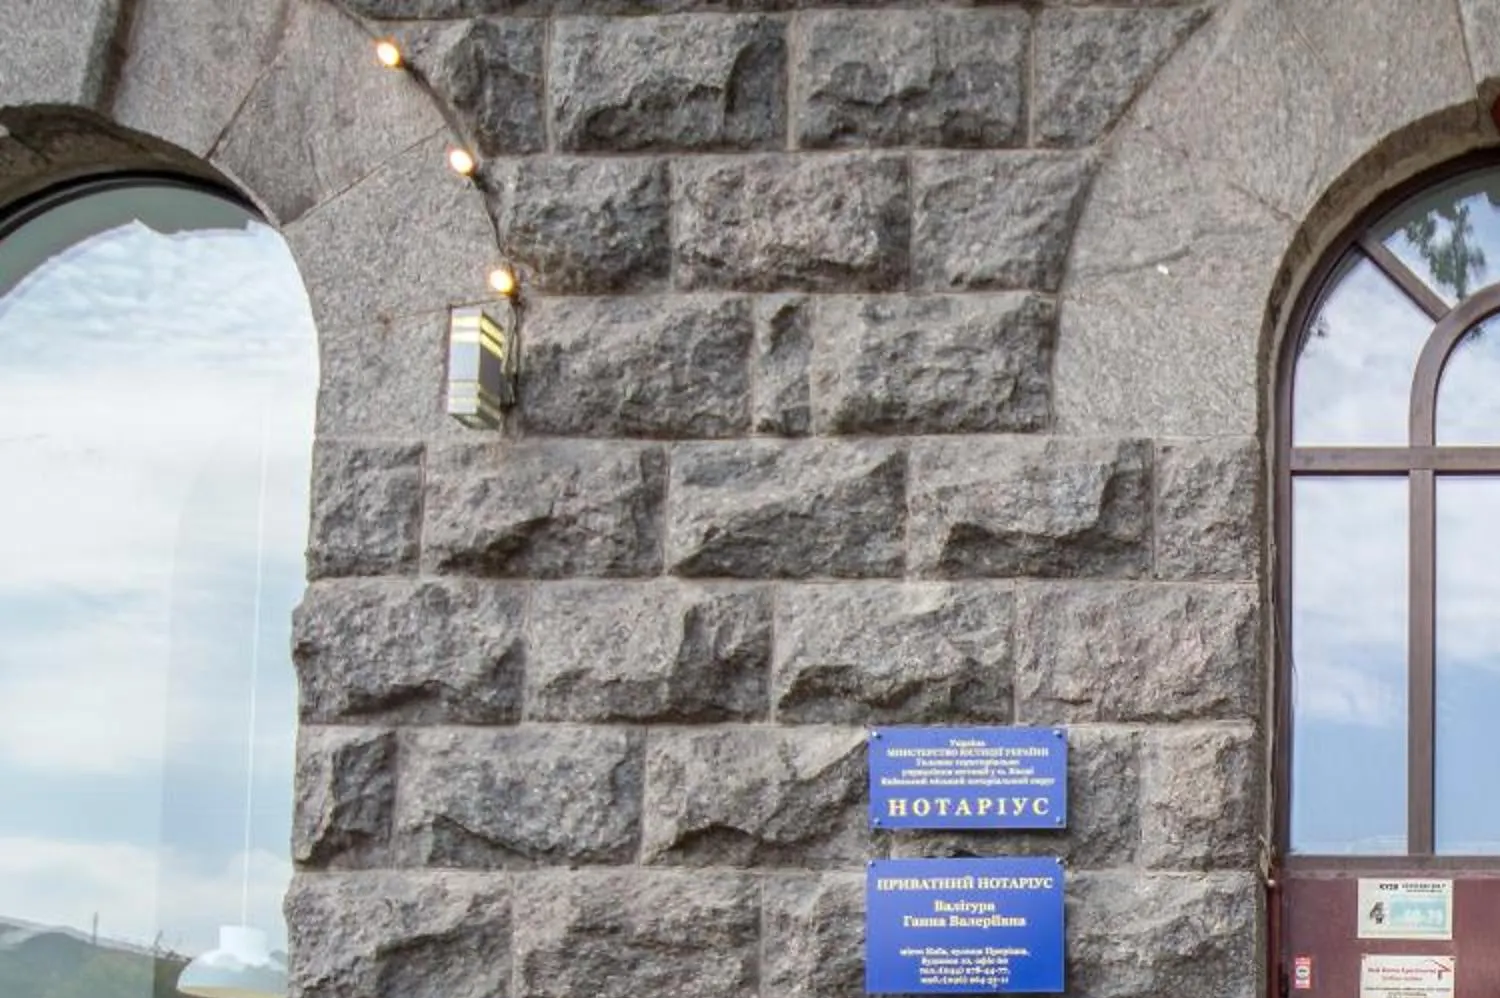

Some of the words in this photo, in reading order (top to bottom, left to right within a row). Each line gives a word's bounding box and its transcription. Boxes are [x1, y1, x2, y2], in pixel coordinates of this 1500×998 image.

[888, 797, 1050, 816] НОТАРІУС
[877, 875, 974, 891] ПРИВАТНИЙ
[977, 877, 1053, 890] НОТАРІУС
